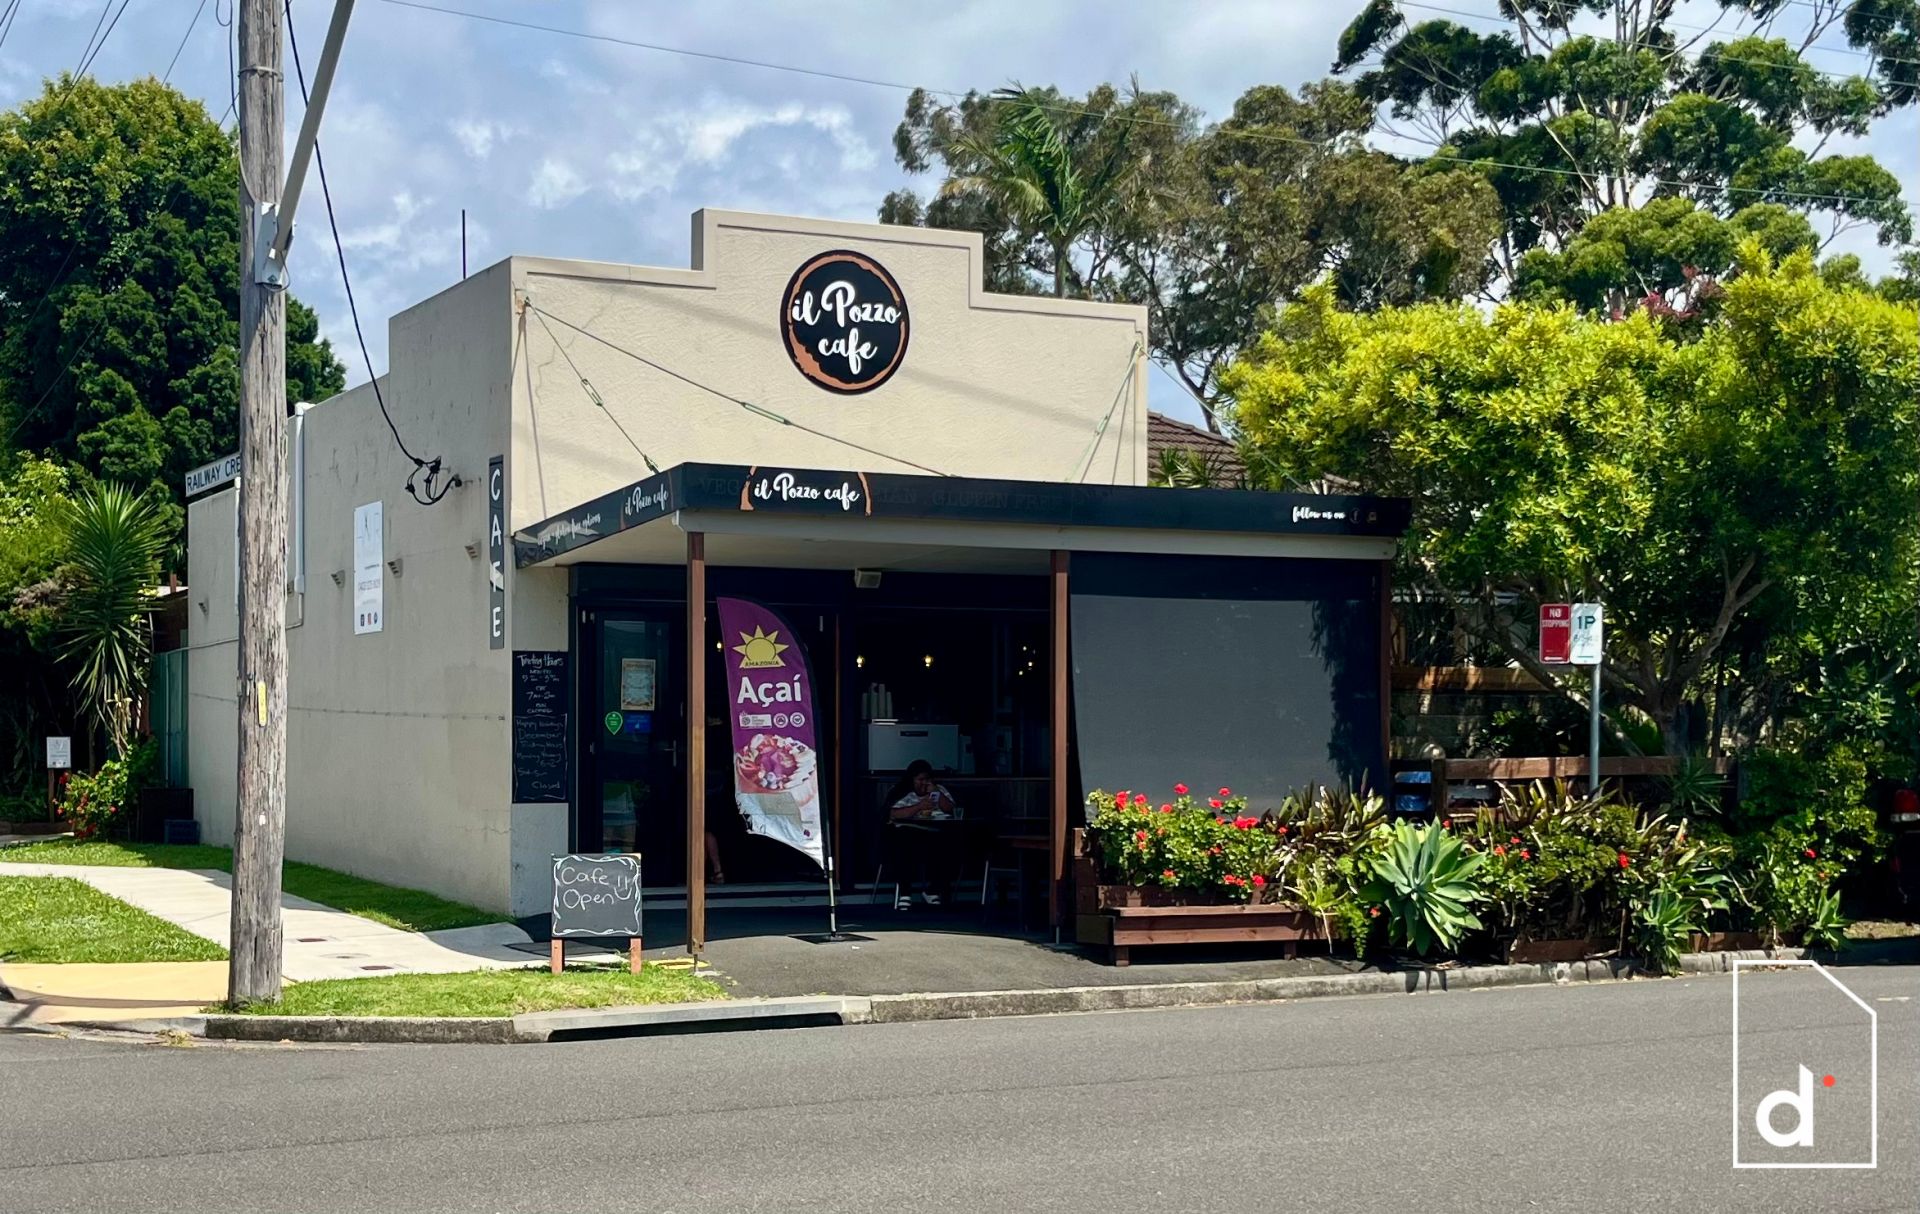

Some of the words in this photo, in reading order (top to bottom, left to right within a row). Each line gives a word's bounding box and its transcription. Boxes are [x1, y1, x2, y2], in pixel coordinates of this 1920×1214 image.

[792, 290, 821, 326] il
[821, 280, 902, 328] Pozzo
[818, 327, 878, 375] cafe
[186, 464, 221, 492] RAILWAY
[225, 455, 241, 477] CRE
[624, 496, 634, 516] il
[632, 486, 652, 513] Pozzo
[653, 483, 669, 511] cafe
[754, 478, 774, 500] il
[773, 472, 821, 502] Pozzo
[823, 481, 860, 511] cafe
[1292, 505, 1321, 523] follow
[1322, 511, 1333, 520] us
[1333, 511, 1347, 520] on
[490, 468, 502, 638] CAFE
[1548, 608, 1563, 618] NO
[1577, 615, 1596, 630] 1P
[737, 674, 802, 708] Açaí
[561, 866, 610, 885] Cafe
[562, 888, 615, 911] Open
